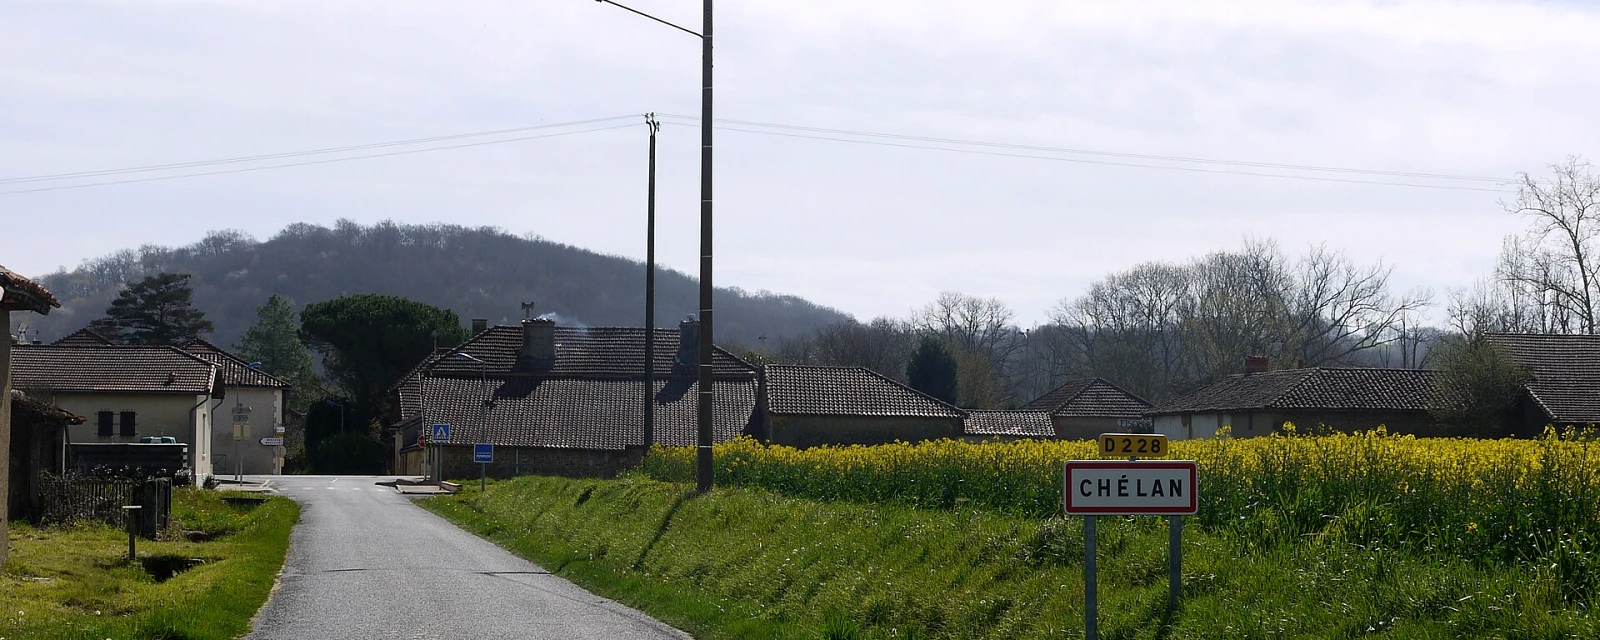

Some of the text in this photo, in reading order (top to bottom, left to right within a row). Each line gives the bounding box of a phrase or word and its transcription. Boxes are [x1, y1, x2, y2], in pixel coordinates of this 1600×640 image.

[1105, 438, 1161, 453] D 228
[1079, 474, 1182, 497] CHÉLAN
